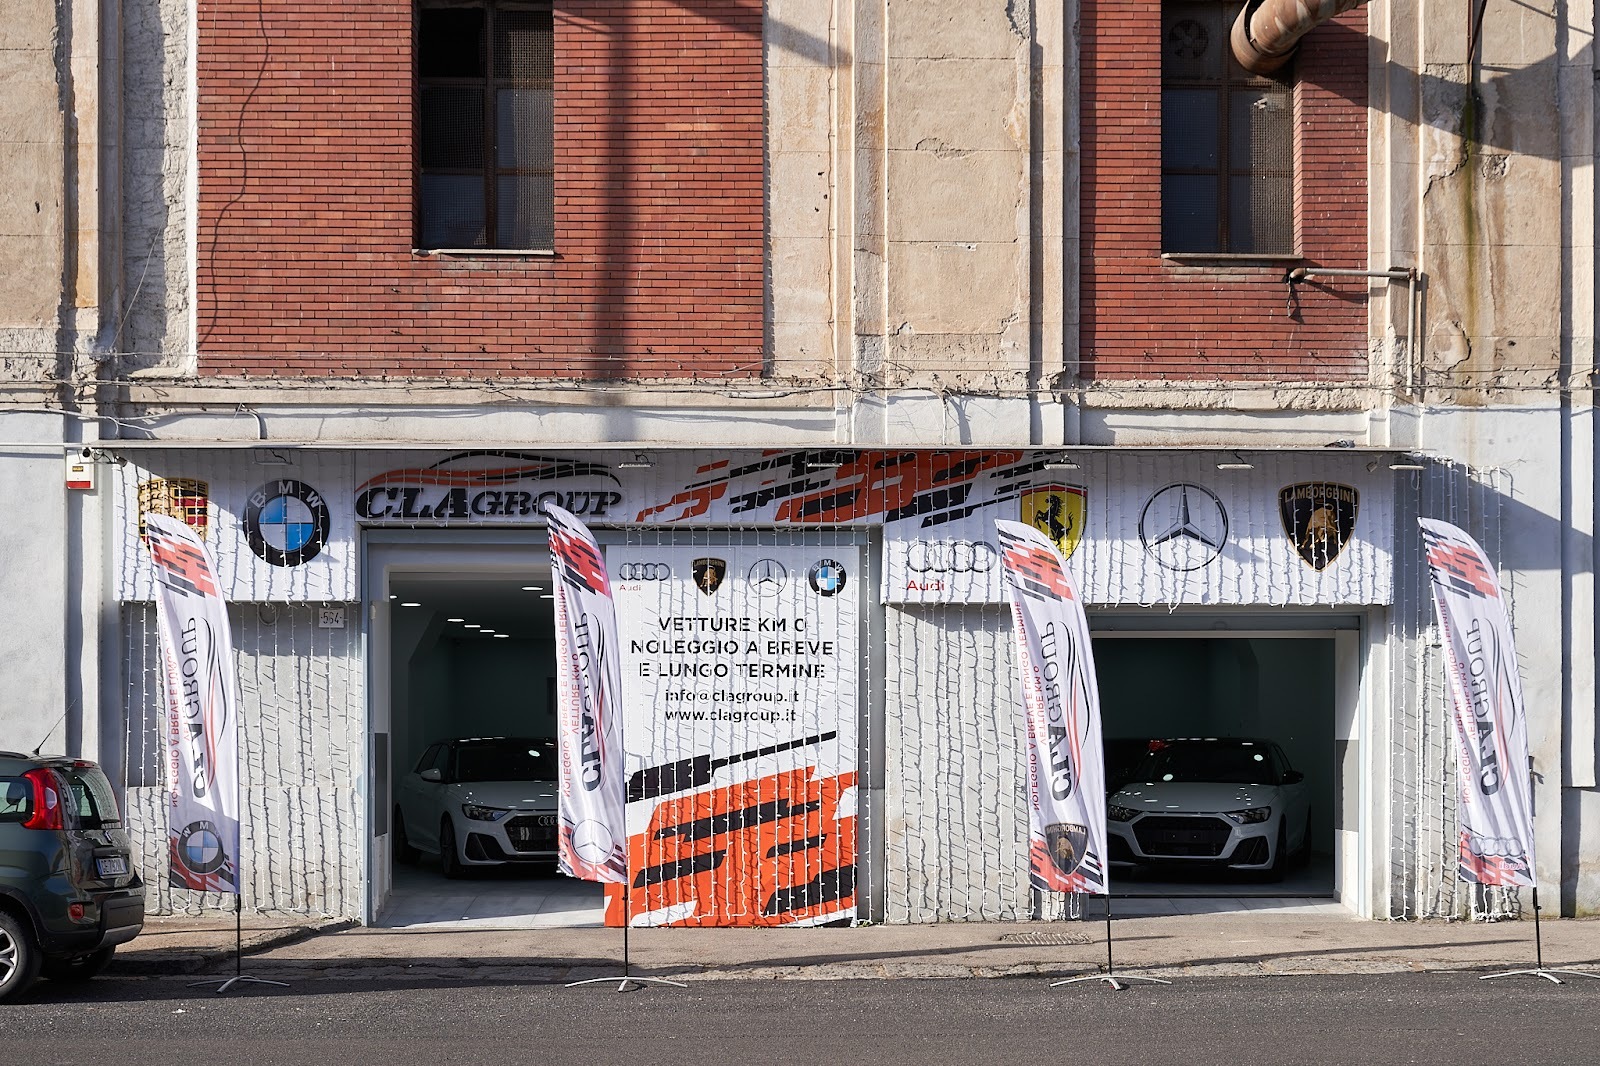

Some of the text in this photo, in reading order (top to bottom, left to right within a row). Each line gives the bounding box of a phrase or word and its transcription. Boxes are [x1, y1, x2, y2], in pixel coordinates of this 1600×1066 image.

[250, 481, 322, 509] BMW
[1284, 486, 1355, 503] LAMBORGHINI
[907, 579, 945, 591] Audi
[658, 616, 751, 632] VETTURE
[758, 616, 786, 632] KM
[630, 640, 834, 655] NOLEGGIO A BREVE
[639, 662, 826, 678] E LUNGO TERMINE
[665, 689, 799, 705] info@clagroup.it
[665, 709, 797, 723] www.clagroup.it
